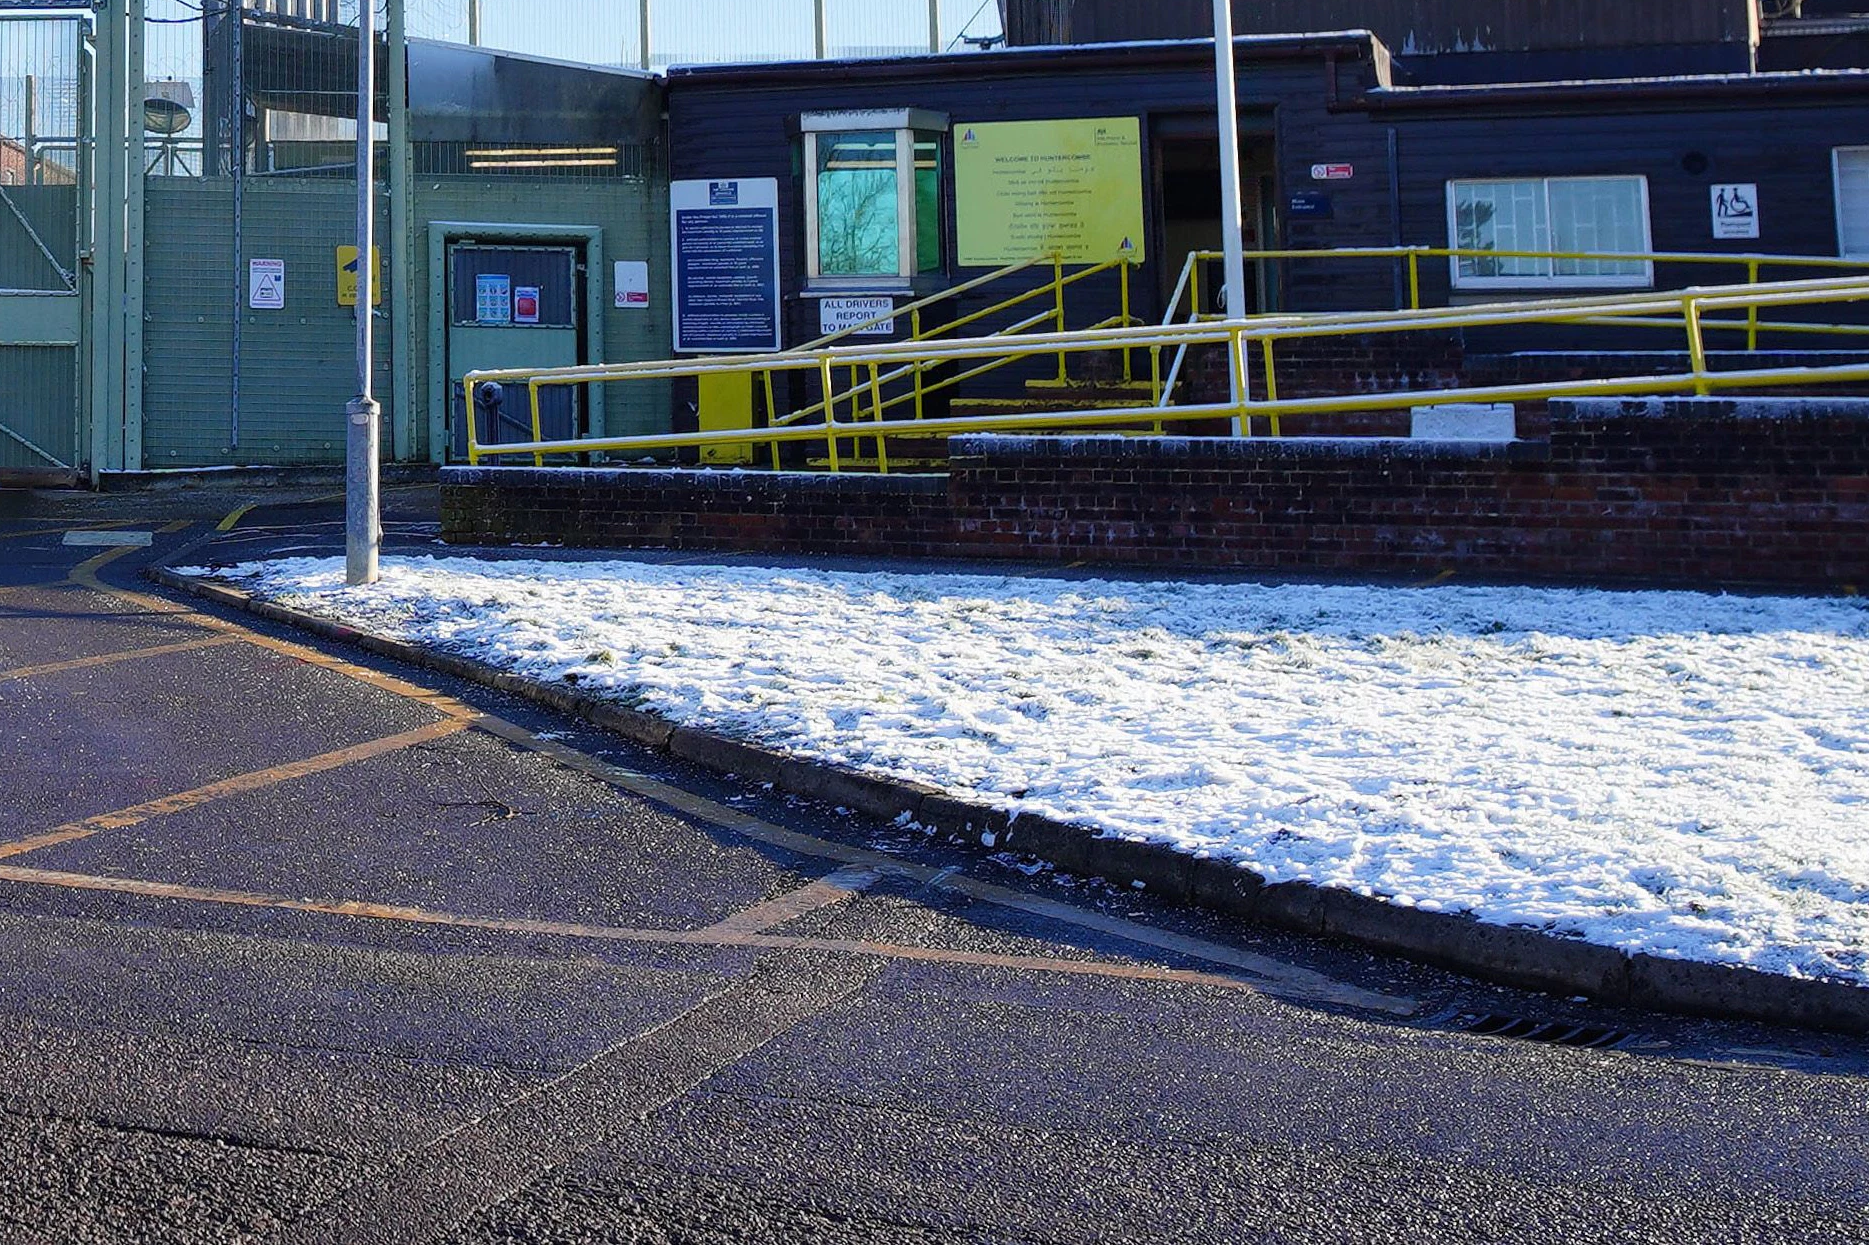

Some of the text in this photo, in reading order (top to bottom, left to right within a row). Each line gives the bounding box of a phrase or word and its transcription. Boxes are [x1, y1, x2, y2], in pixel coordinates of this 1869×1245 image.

[824, 299, 890, 309] ALL DRIVERS
[836, 311, 877, 321] REPORT
[823, 323, 836, 332] TO
